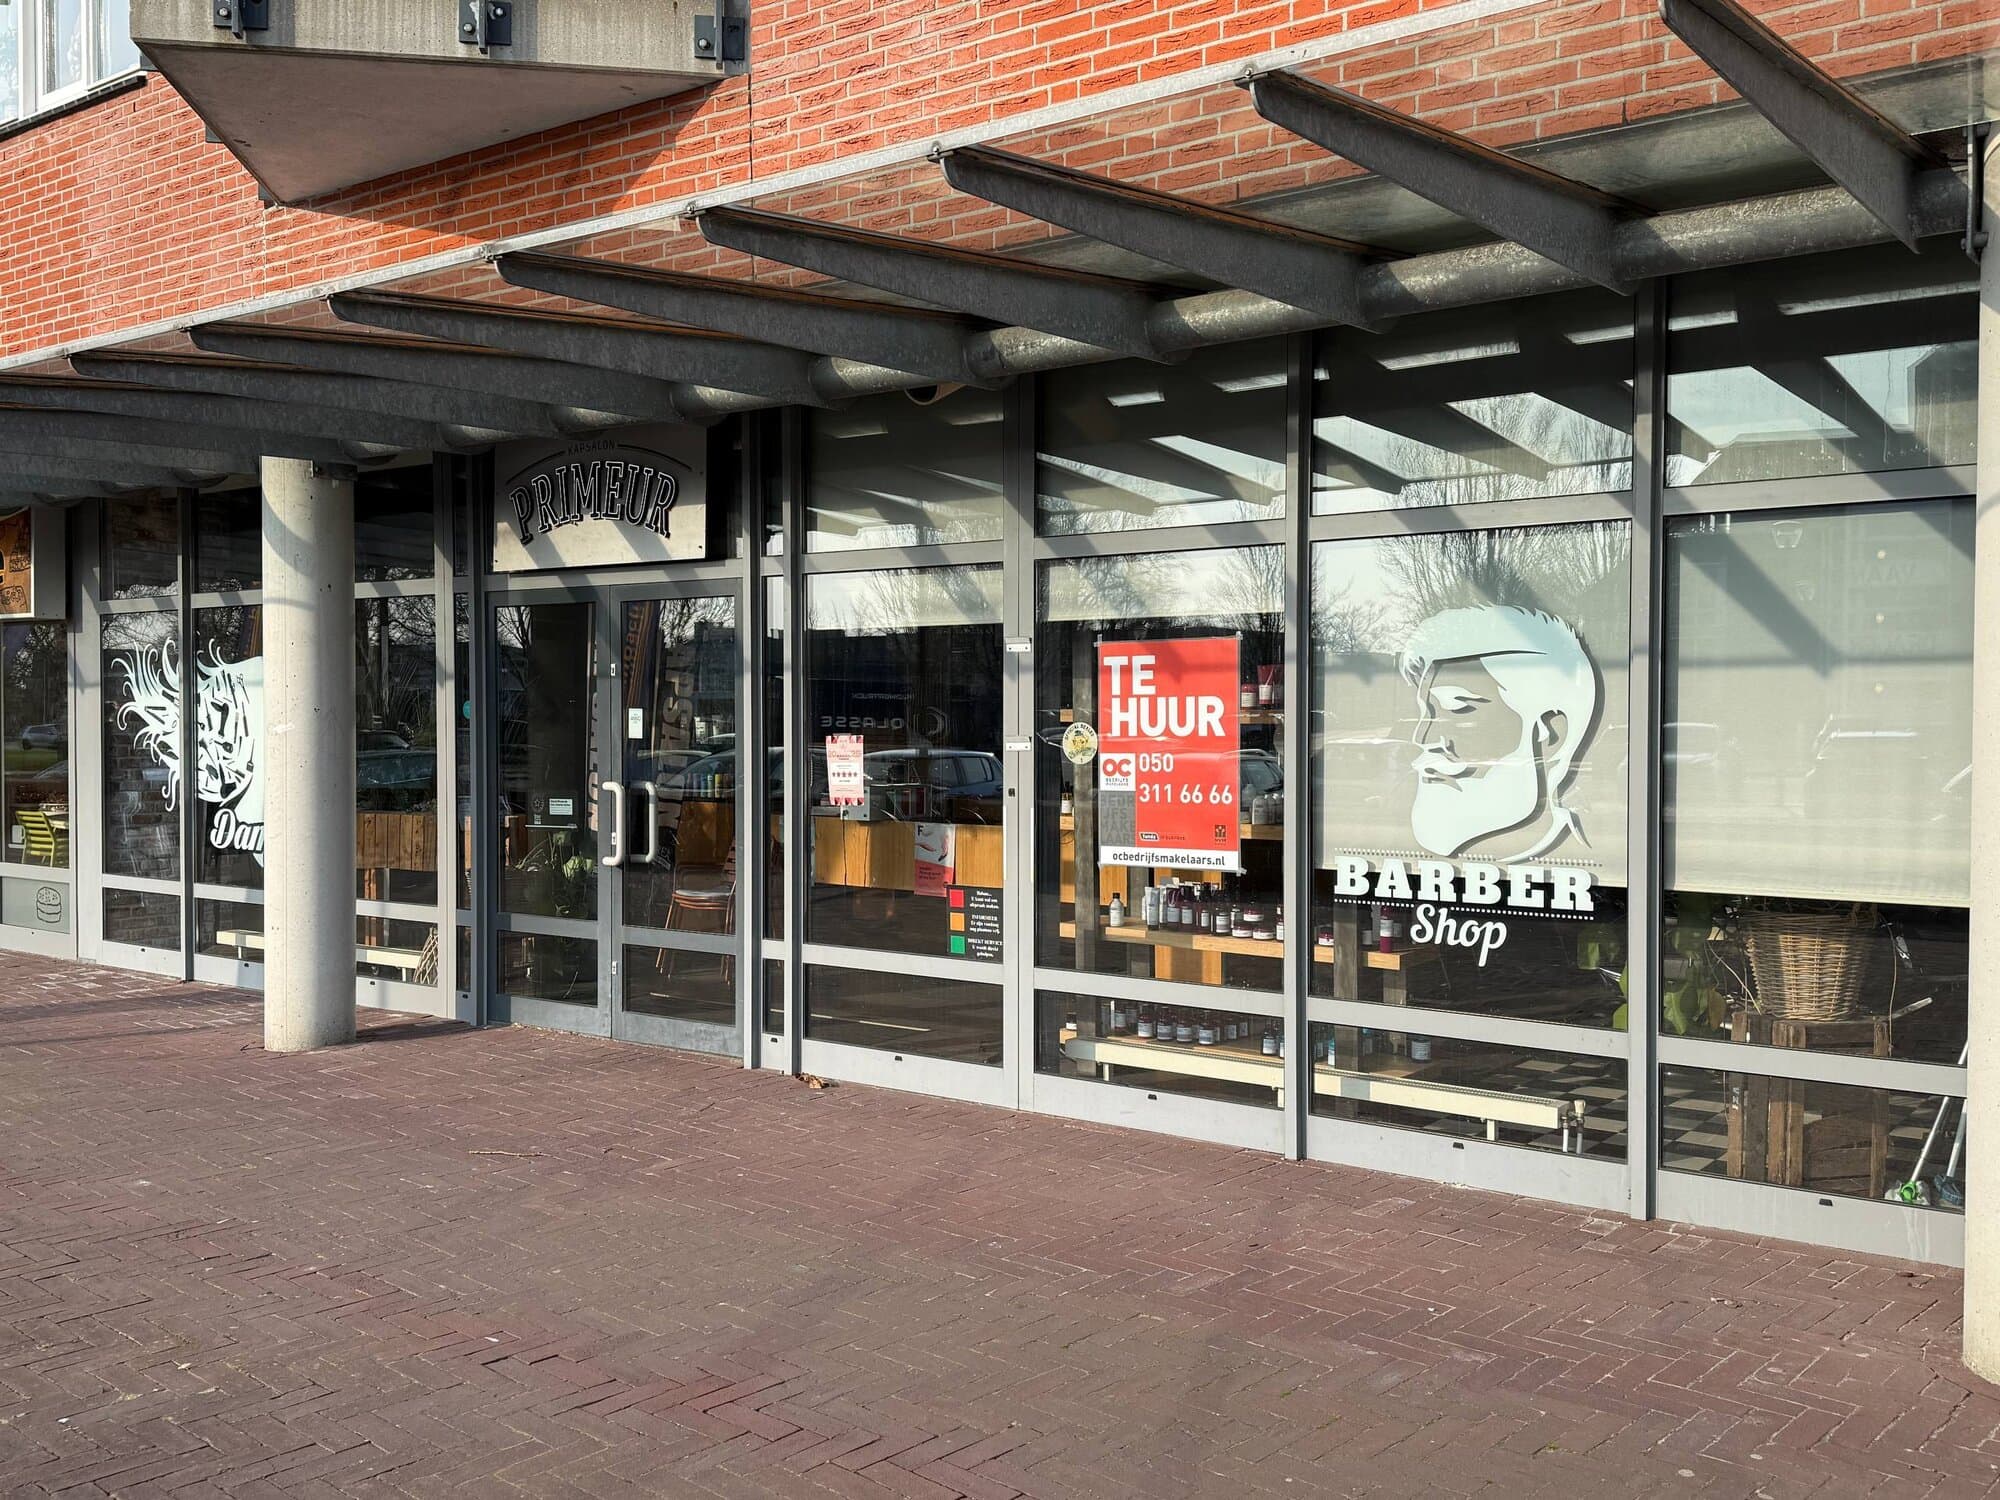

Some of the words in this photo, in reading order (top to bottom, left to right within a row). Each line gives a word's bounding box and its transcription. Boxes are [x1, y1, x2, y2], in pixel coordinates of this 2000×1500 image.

[567, 439, 616, 456] KAPSALON
[509, 460, 679, 545] PRIMEUR
[1103, 655, 1156, 696] TE
[1111, 696, 1226, 737] HUUR
[1102, 758, 1132, 776] OC
[1139, 753, 1174, 772] 050
[1139, 784, 1172, 803] 311
[1180, 784, 1203, 804] 66
[1209, 785, 1233, 805] 66
[1112, 851, 1226, 866] ocbedrijfsmakelaars.nl
[1334, 855, 1595, 912] BARBER
[1410, 903, 1508, 968] Shop
